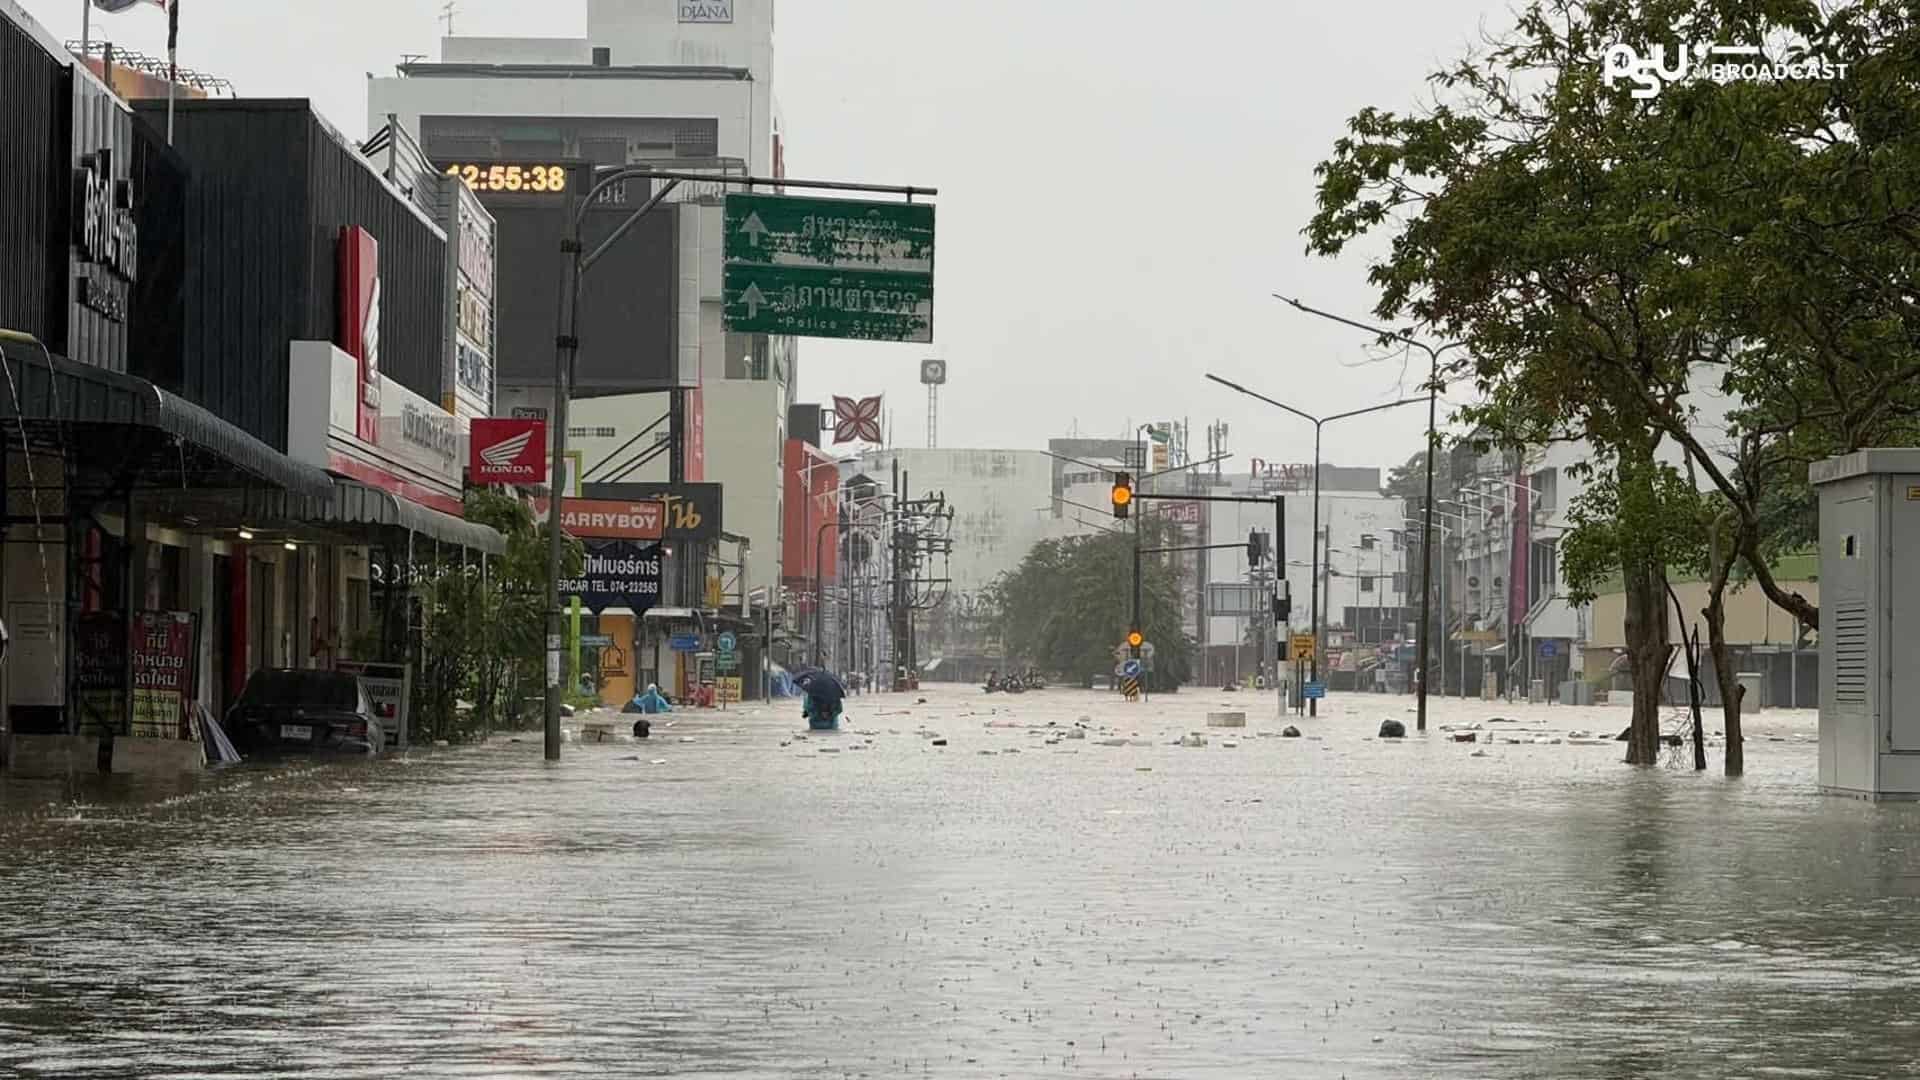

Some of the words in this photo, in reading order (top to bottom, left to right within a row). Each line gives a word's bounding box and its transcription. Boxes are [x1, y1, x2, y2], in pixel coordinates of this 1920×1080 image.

[681, 4, 729, 19] DIANA
[786, 316, 837, 330] Police
[480, 465, 534, 474] HONDA
[560, 511, 657, 530] ARRYBOY
[557, 579, 588, 592] ERCAR
